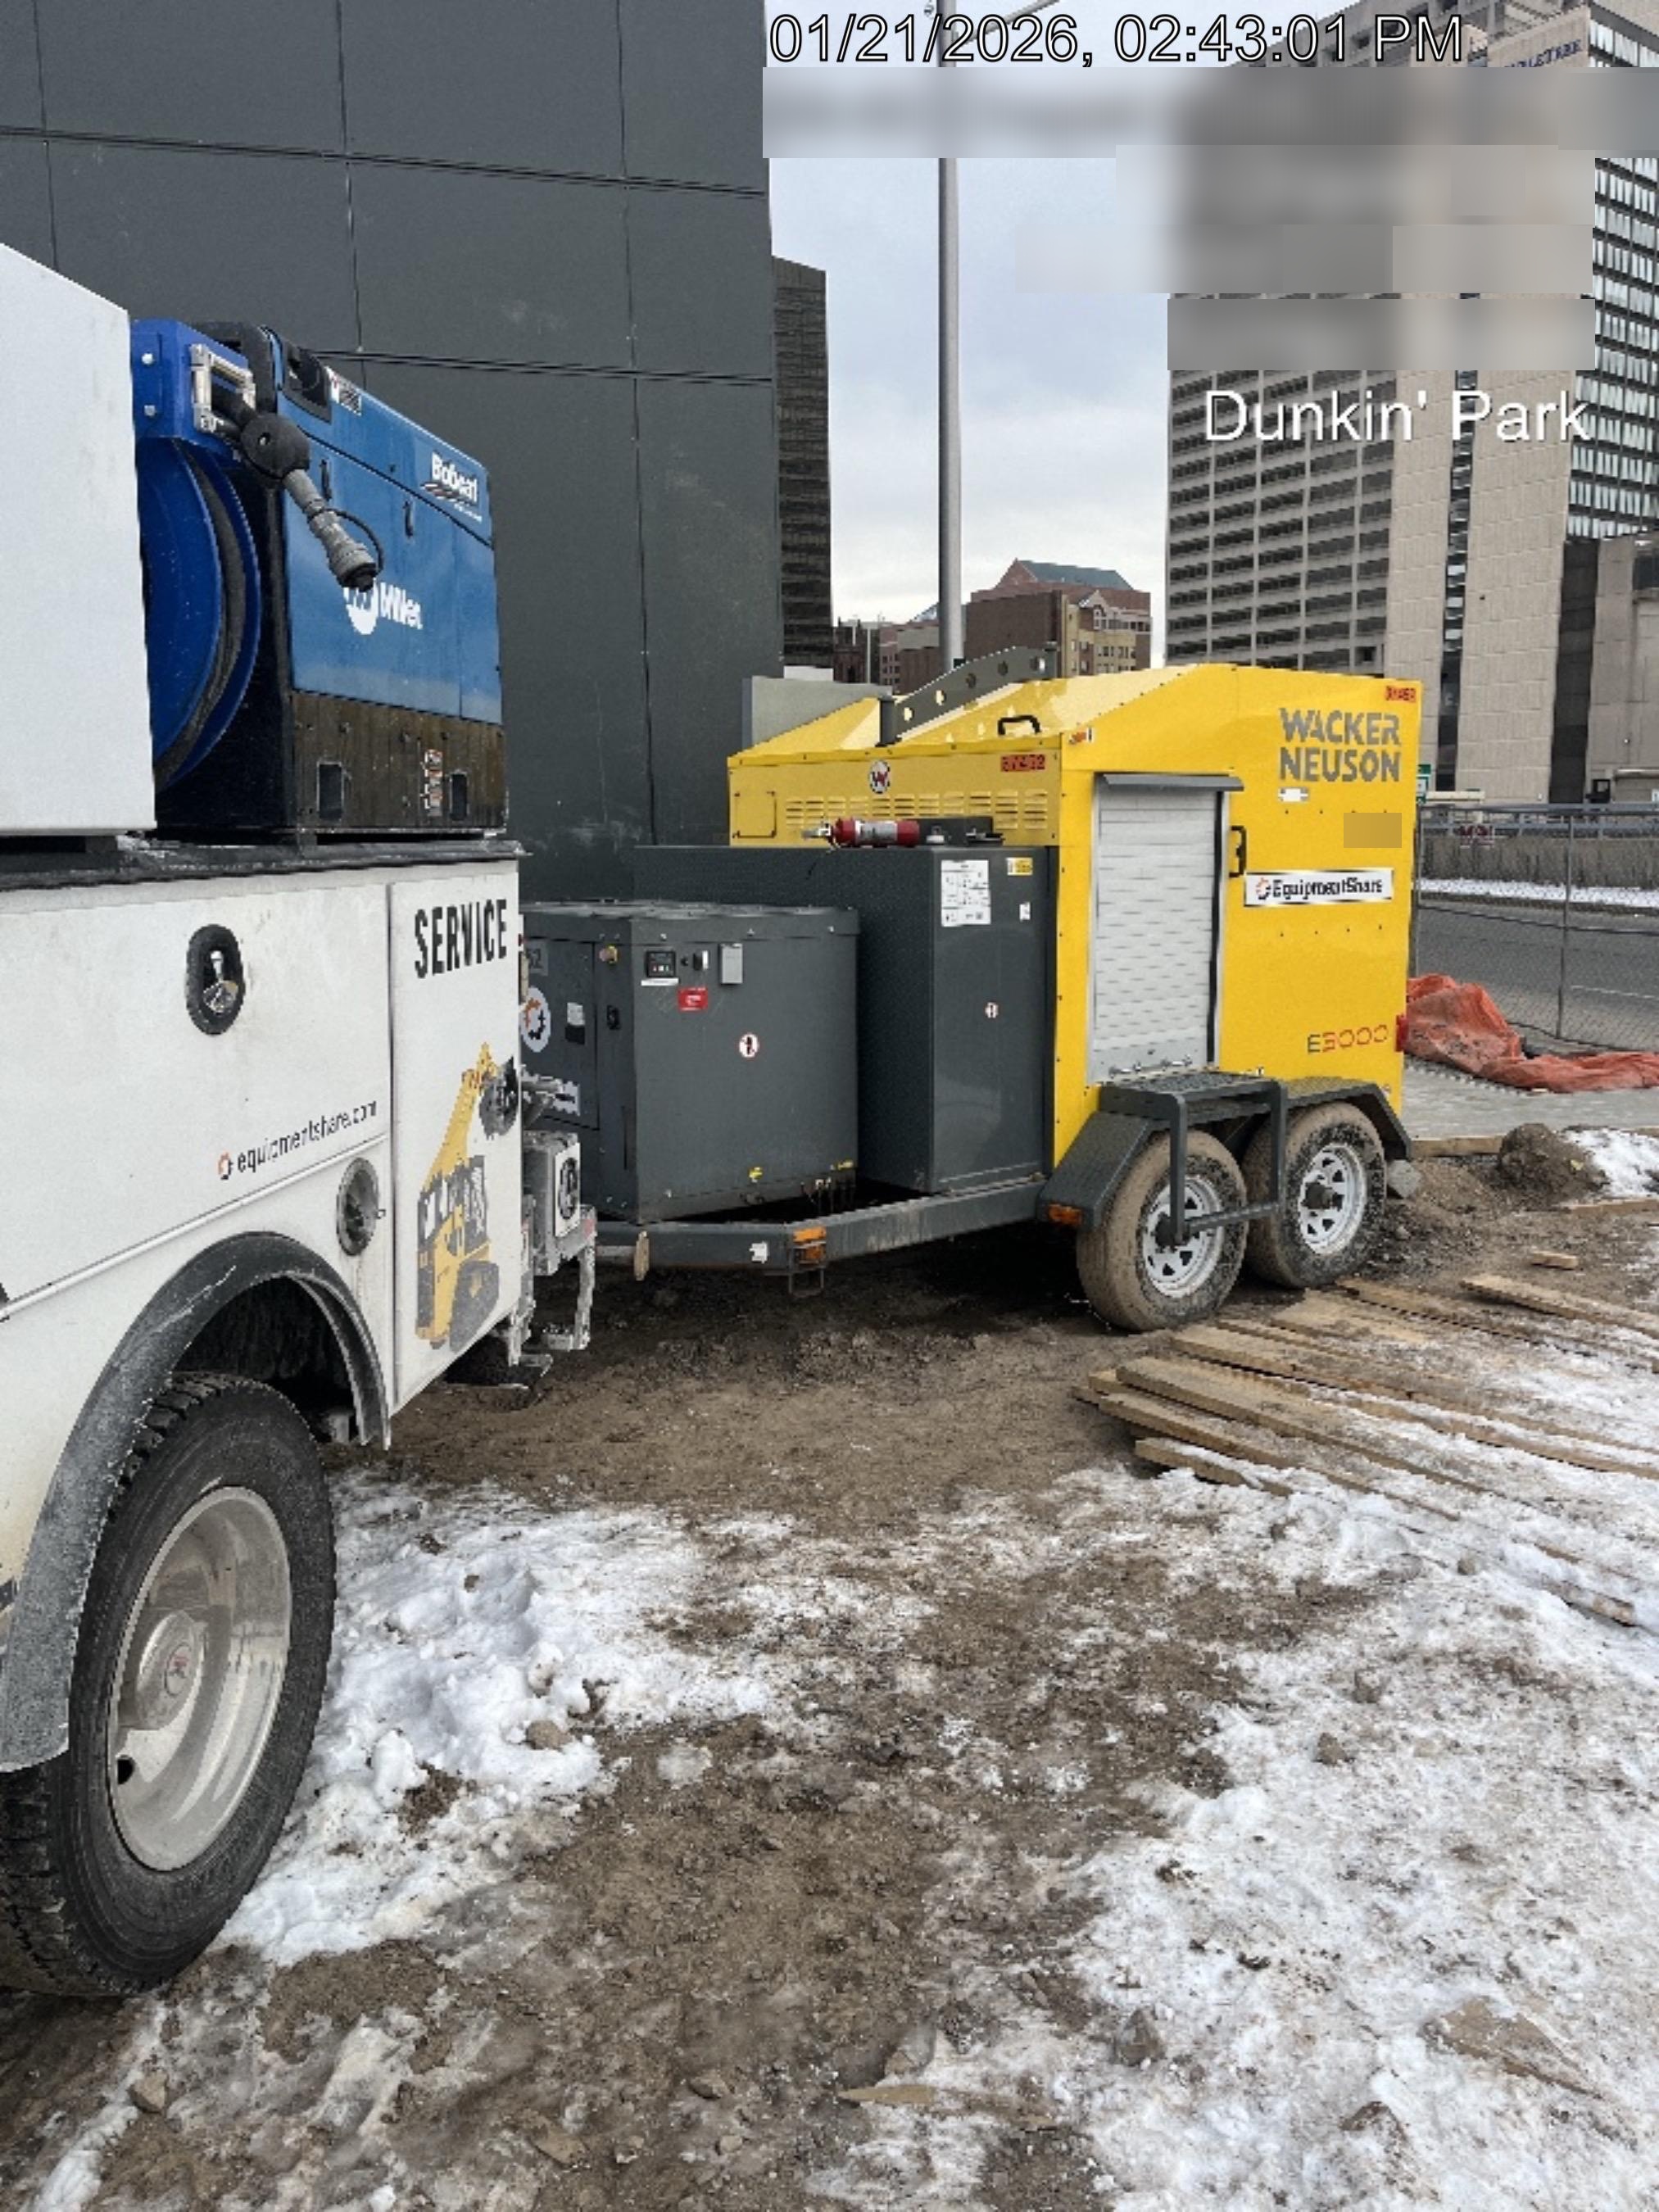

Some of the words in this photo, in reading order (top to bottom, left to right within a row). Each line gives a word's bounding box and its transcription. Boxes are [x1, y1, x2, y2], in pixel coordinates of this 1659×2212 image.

[1279, 707, 1402, 746] WACKER
[1280, 746, 1400, 782] NEUSON
[1272, 877, 1383, 900] EquipmentShare
[415, 899, 507, 979] SERVICE
